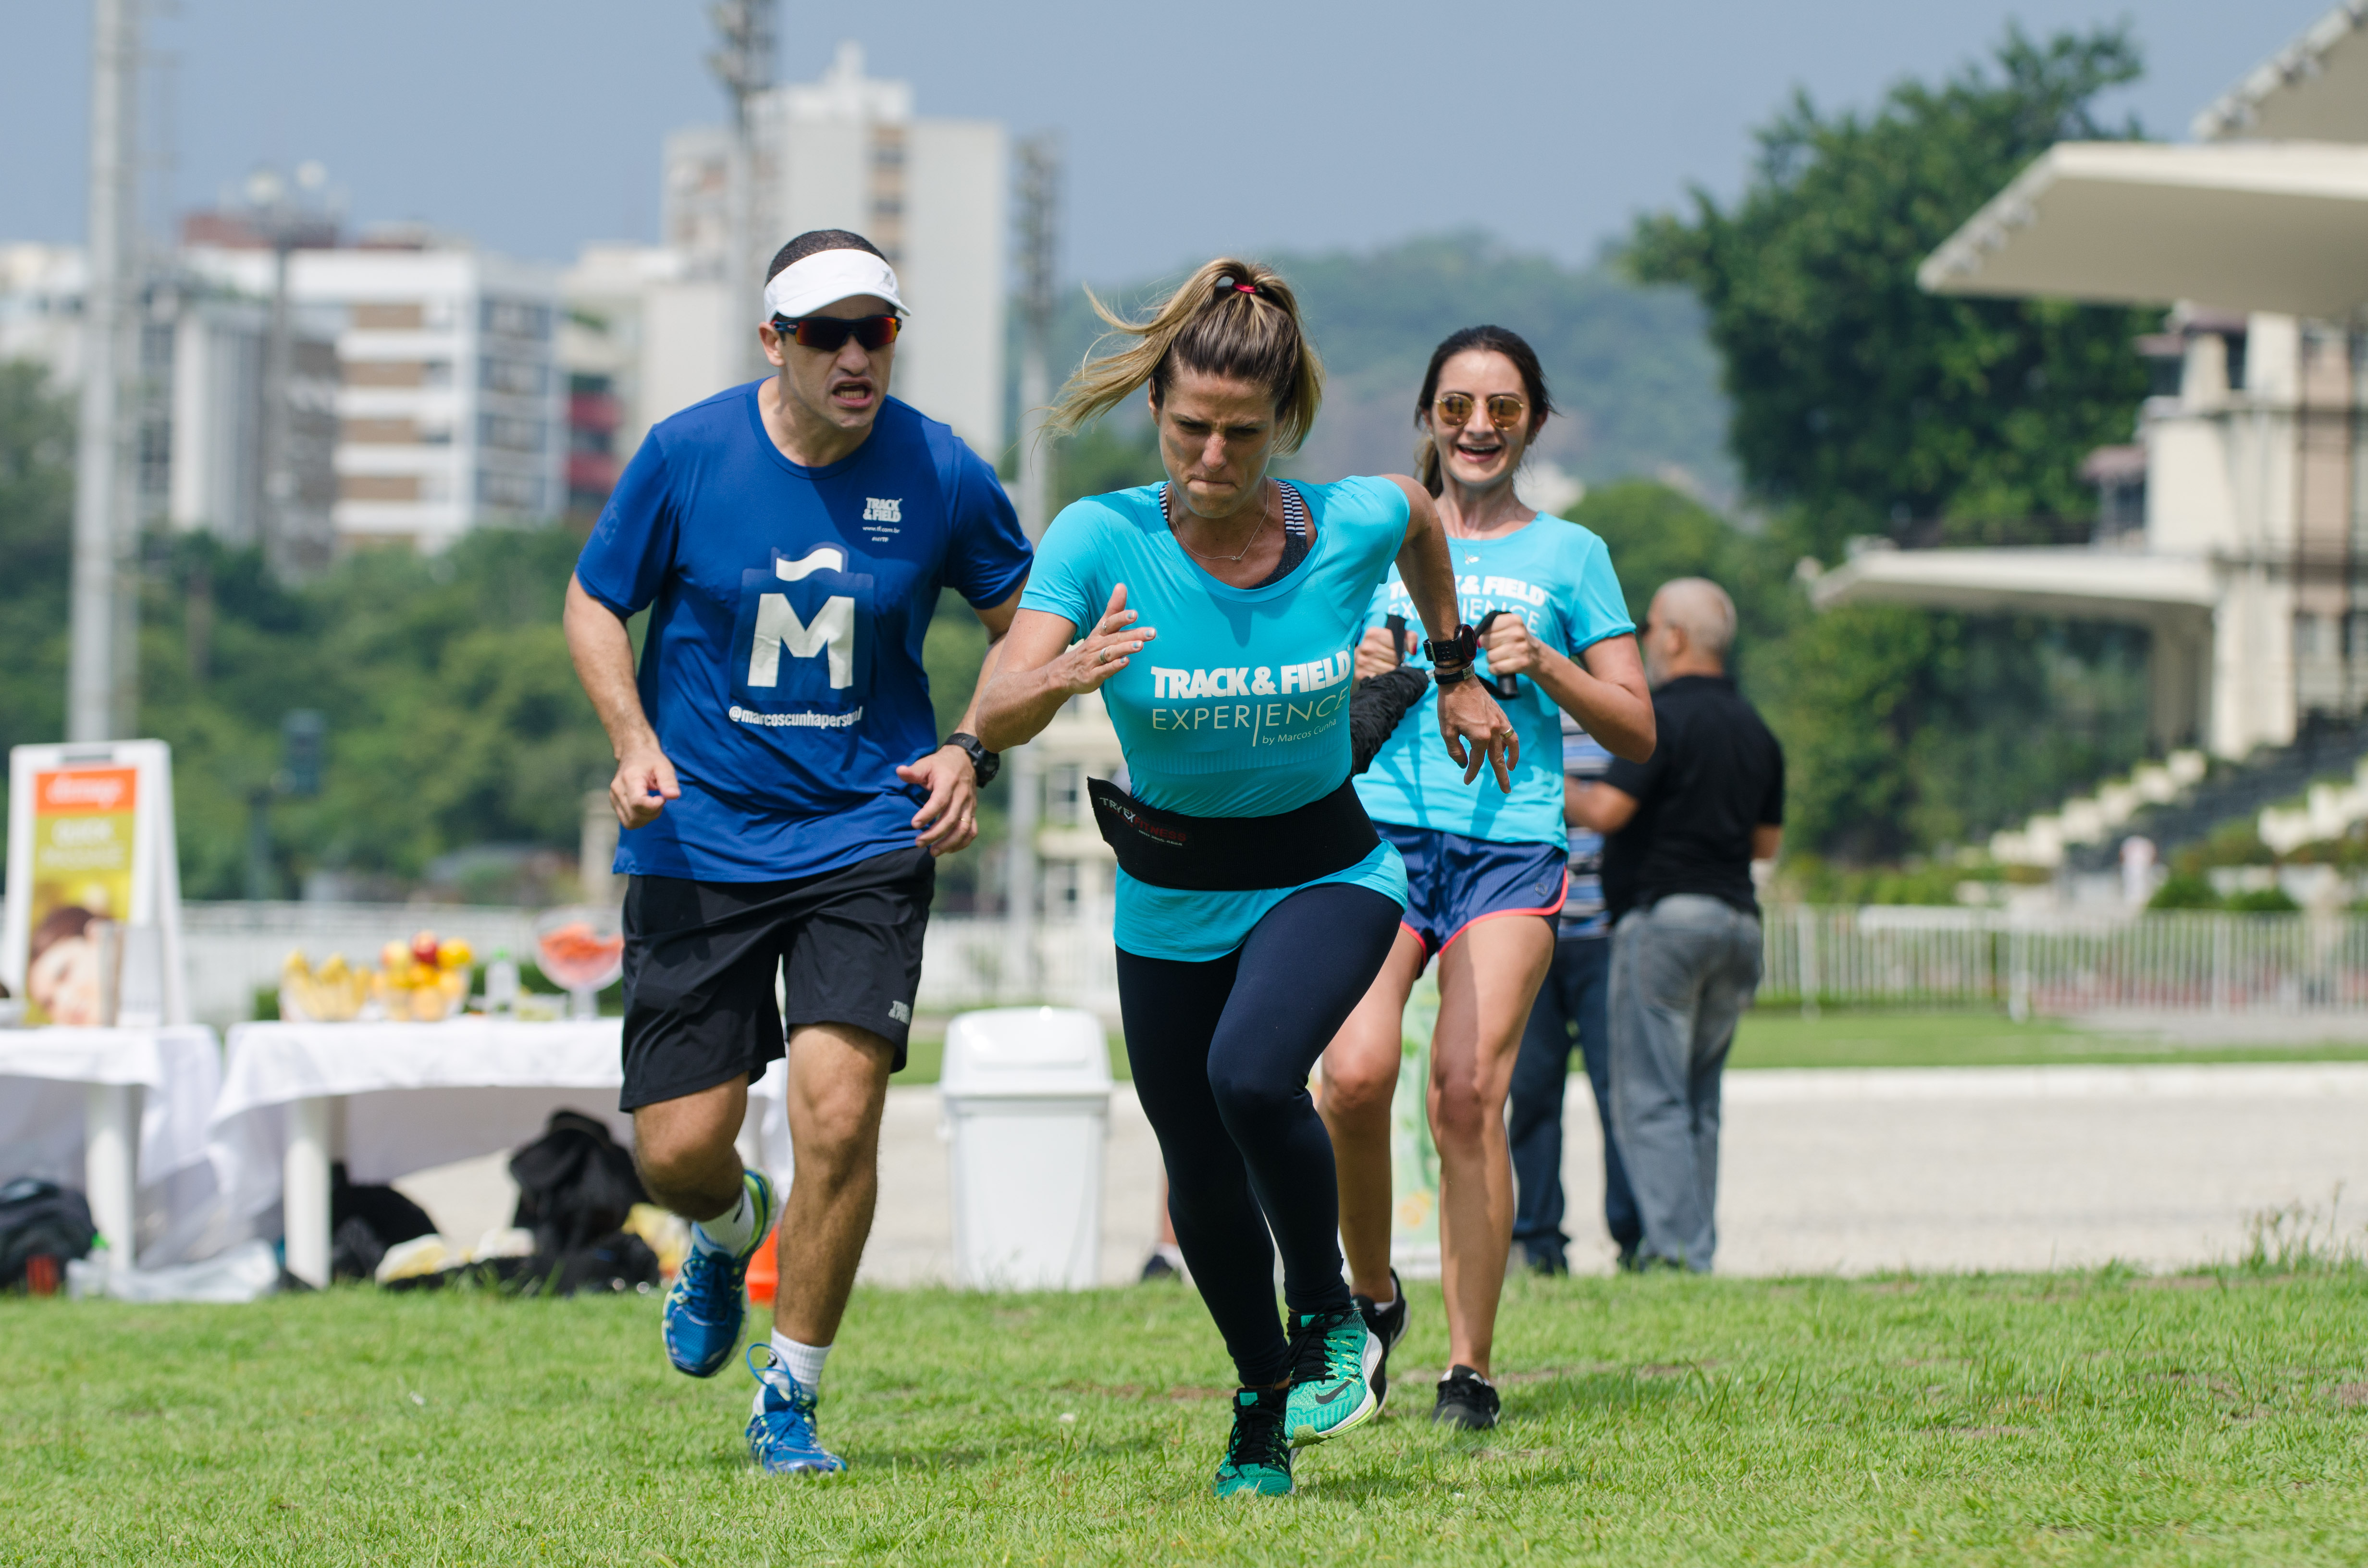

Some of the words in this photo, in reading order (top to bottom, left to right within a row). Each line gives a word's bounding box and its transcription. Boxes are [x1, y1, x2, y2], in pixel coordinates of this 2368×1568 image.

[863, 508, 872, 520] &
[872, 509, 901, 522] FIELD
[866, 497, 900, 511] TRACK
[1460, 575, 1480, 595] &
[1482, 576, 1545, 607] FIELD
[1151, 666, 1250, 699] TRACK
[1251, 666, 1278, 696] &
[1281, 650, 1351, 694] FIELD
[1152, 685, 1349, 747] EXPERIENCE
[1262, 735, 1275, 746] by
[1278, 730, 1312, 742] Marcos
[1314, 718, 1336, 735] Cunha
